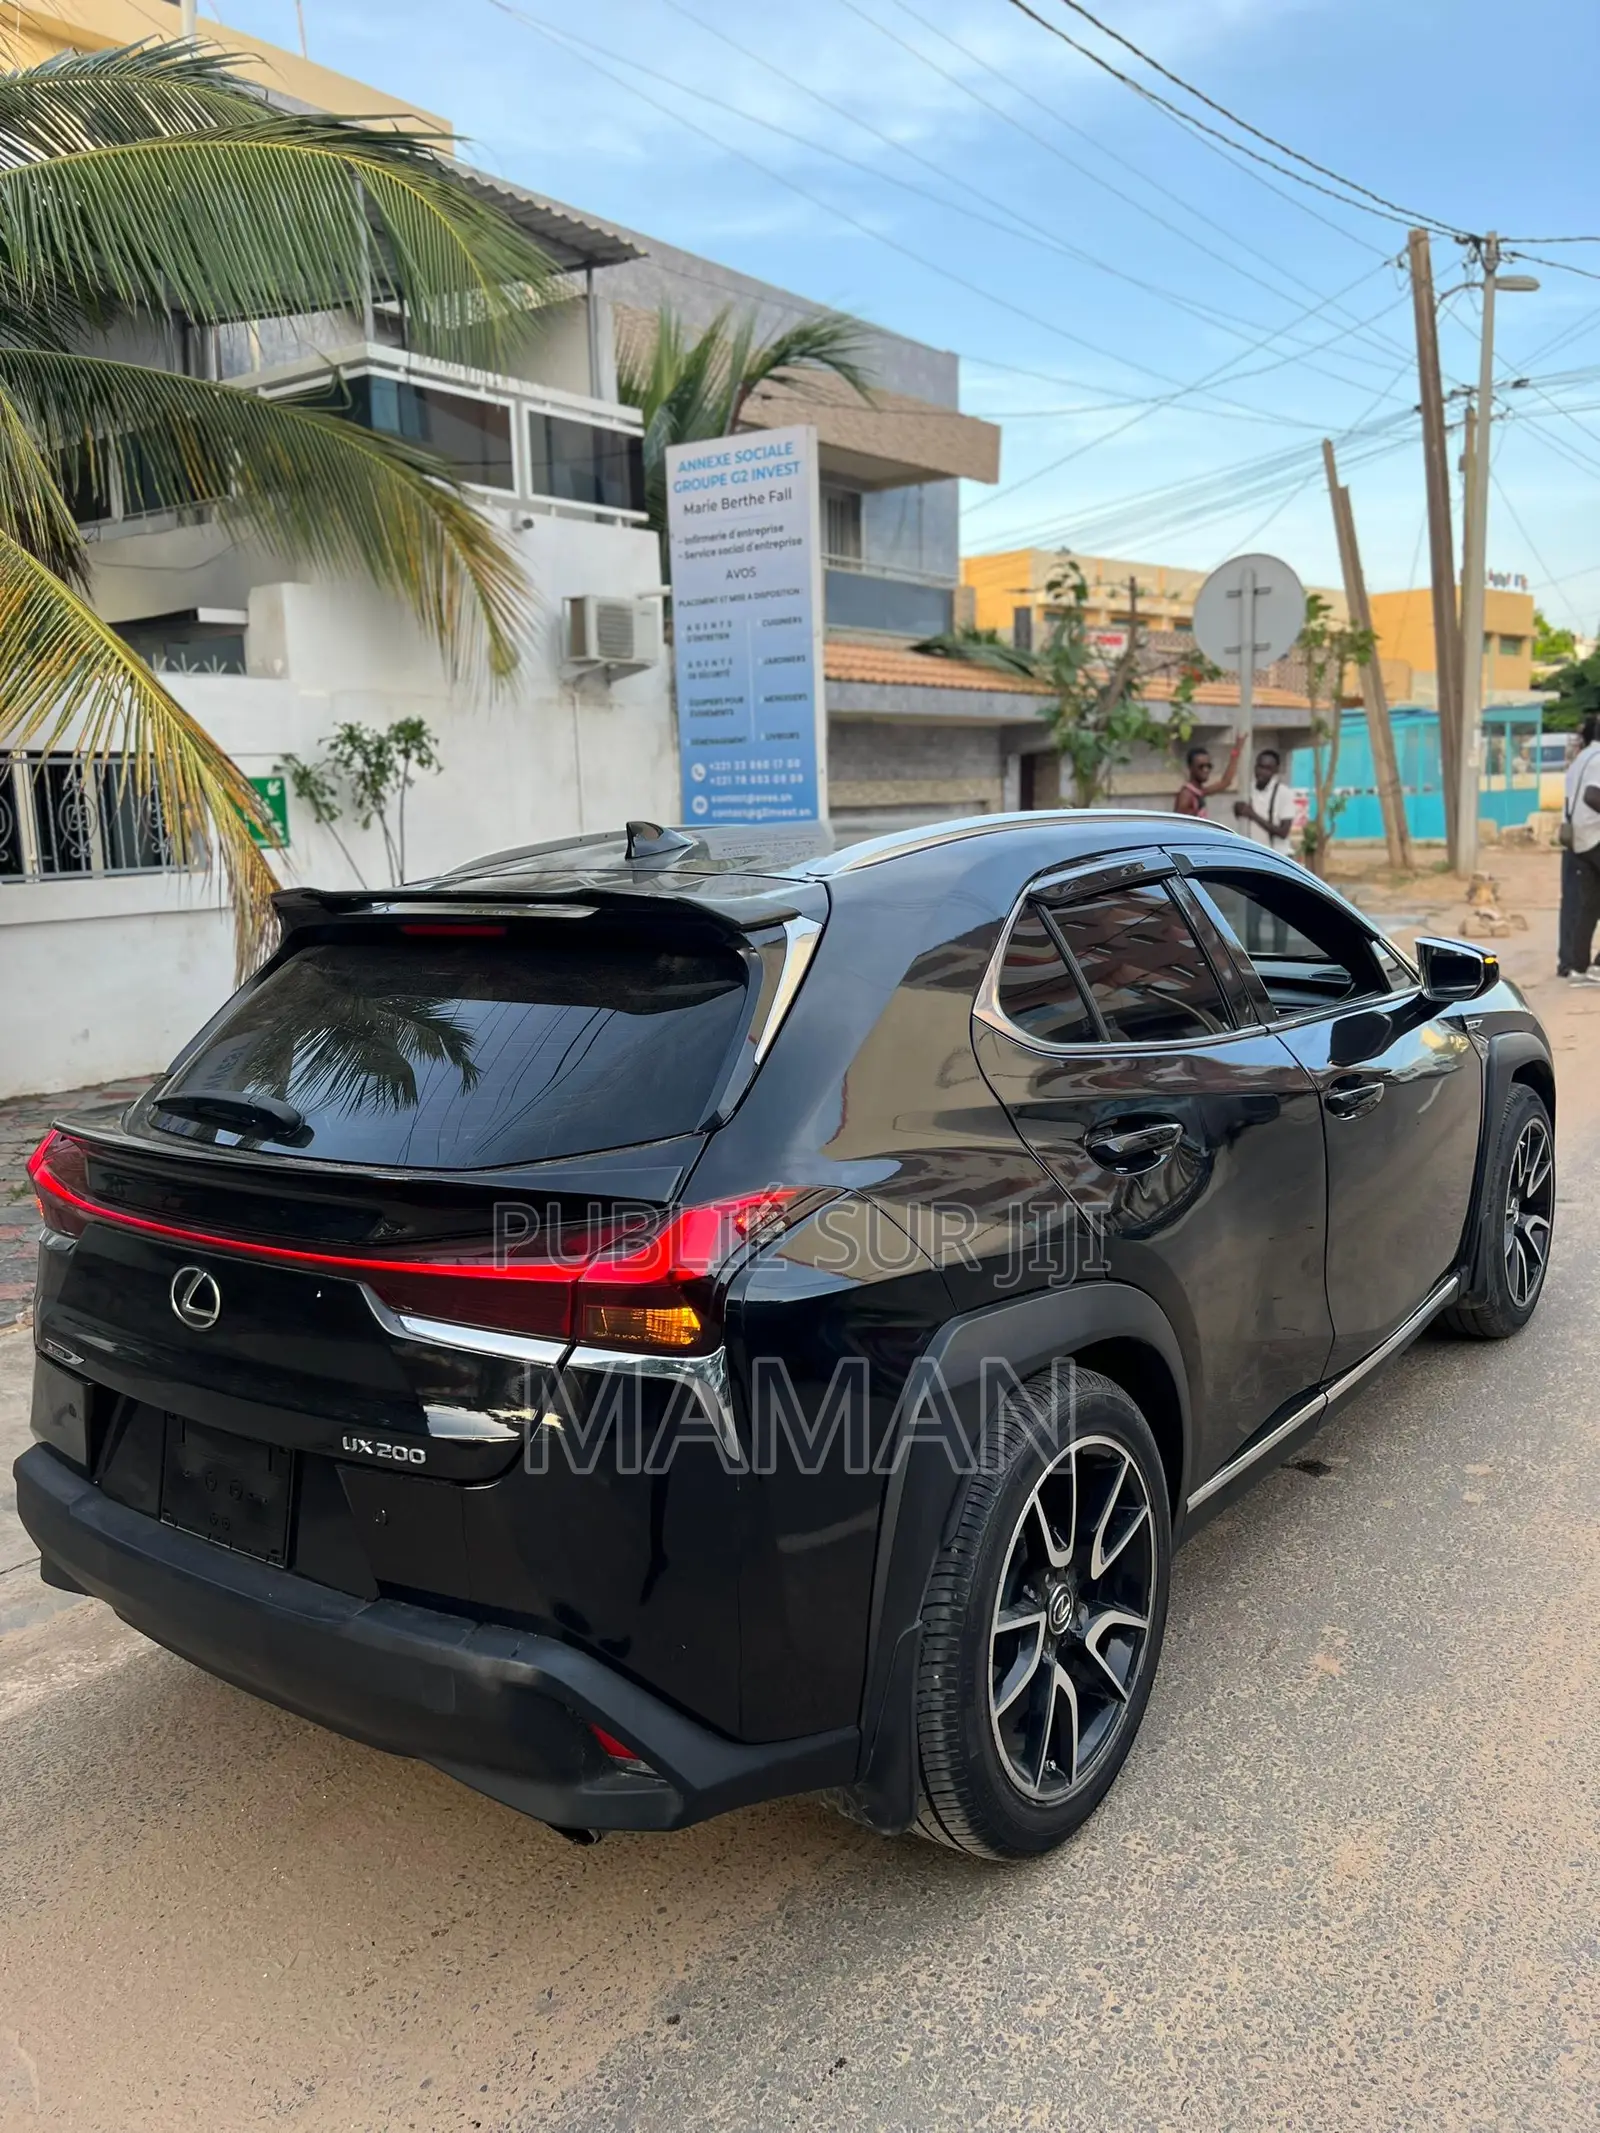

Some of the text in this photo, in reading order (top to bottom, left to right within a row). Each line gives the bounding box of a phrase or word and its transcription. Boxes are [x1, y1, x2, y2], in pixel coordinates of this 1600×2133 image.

[678, 442, 794, 473] ANNEXE SOCIALE
[673, 461, 801, 493] GROUPE G2 INVEST
[683, 486, 793, 516] Marie Berthe Fall
[684, 523, 785, 546] Infirmerie d'entreprise
[684, 536, 804, 560] Service social d'entreprise
[725, 565, 758, 581] AVOS
